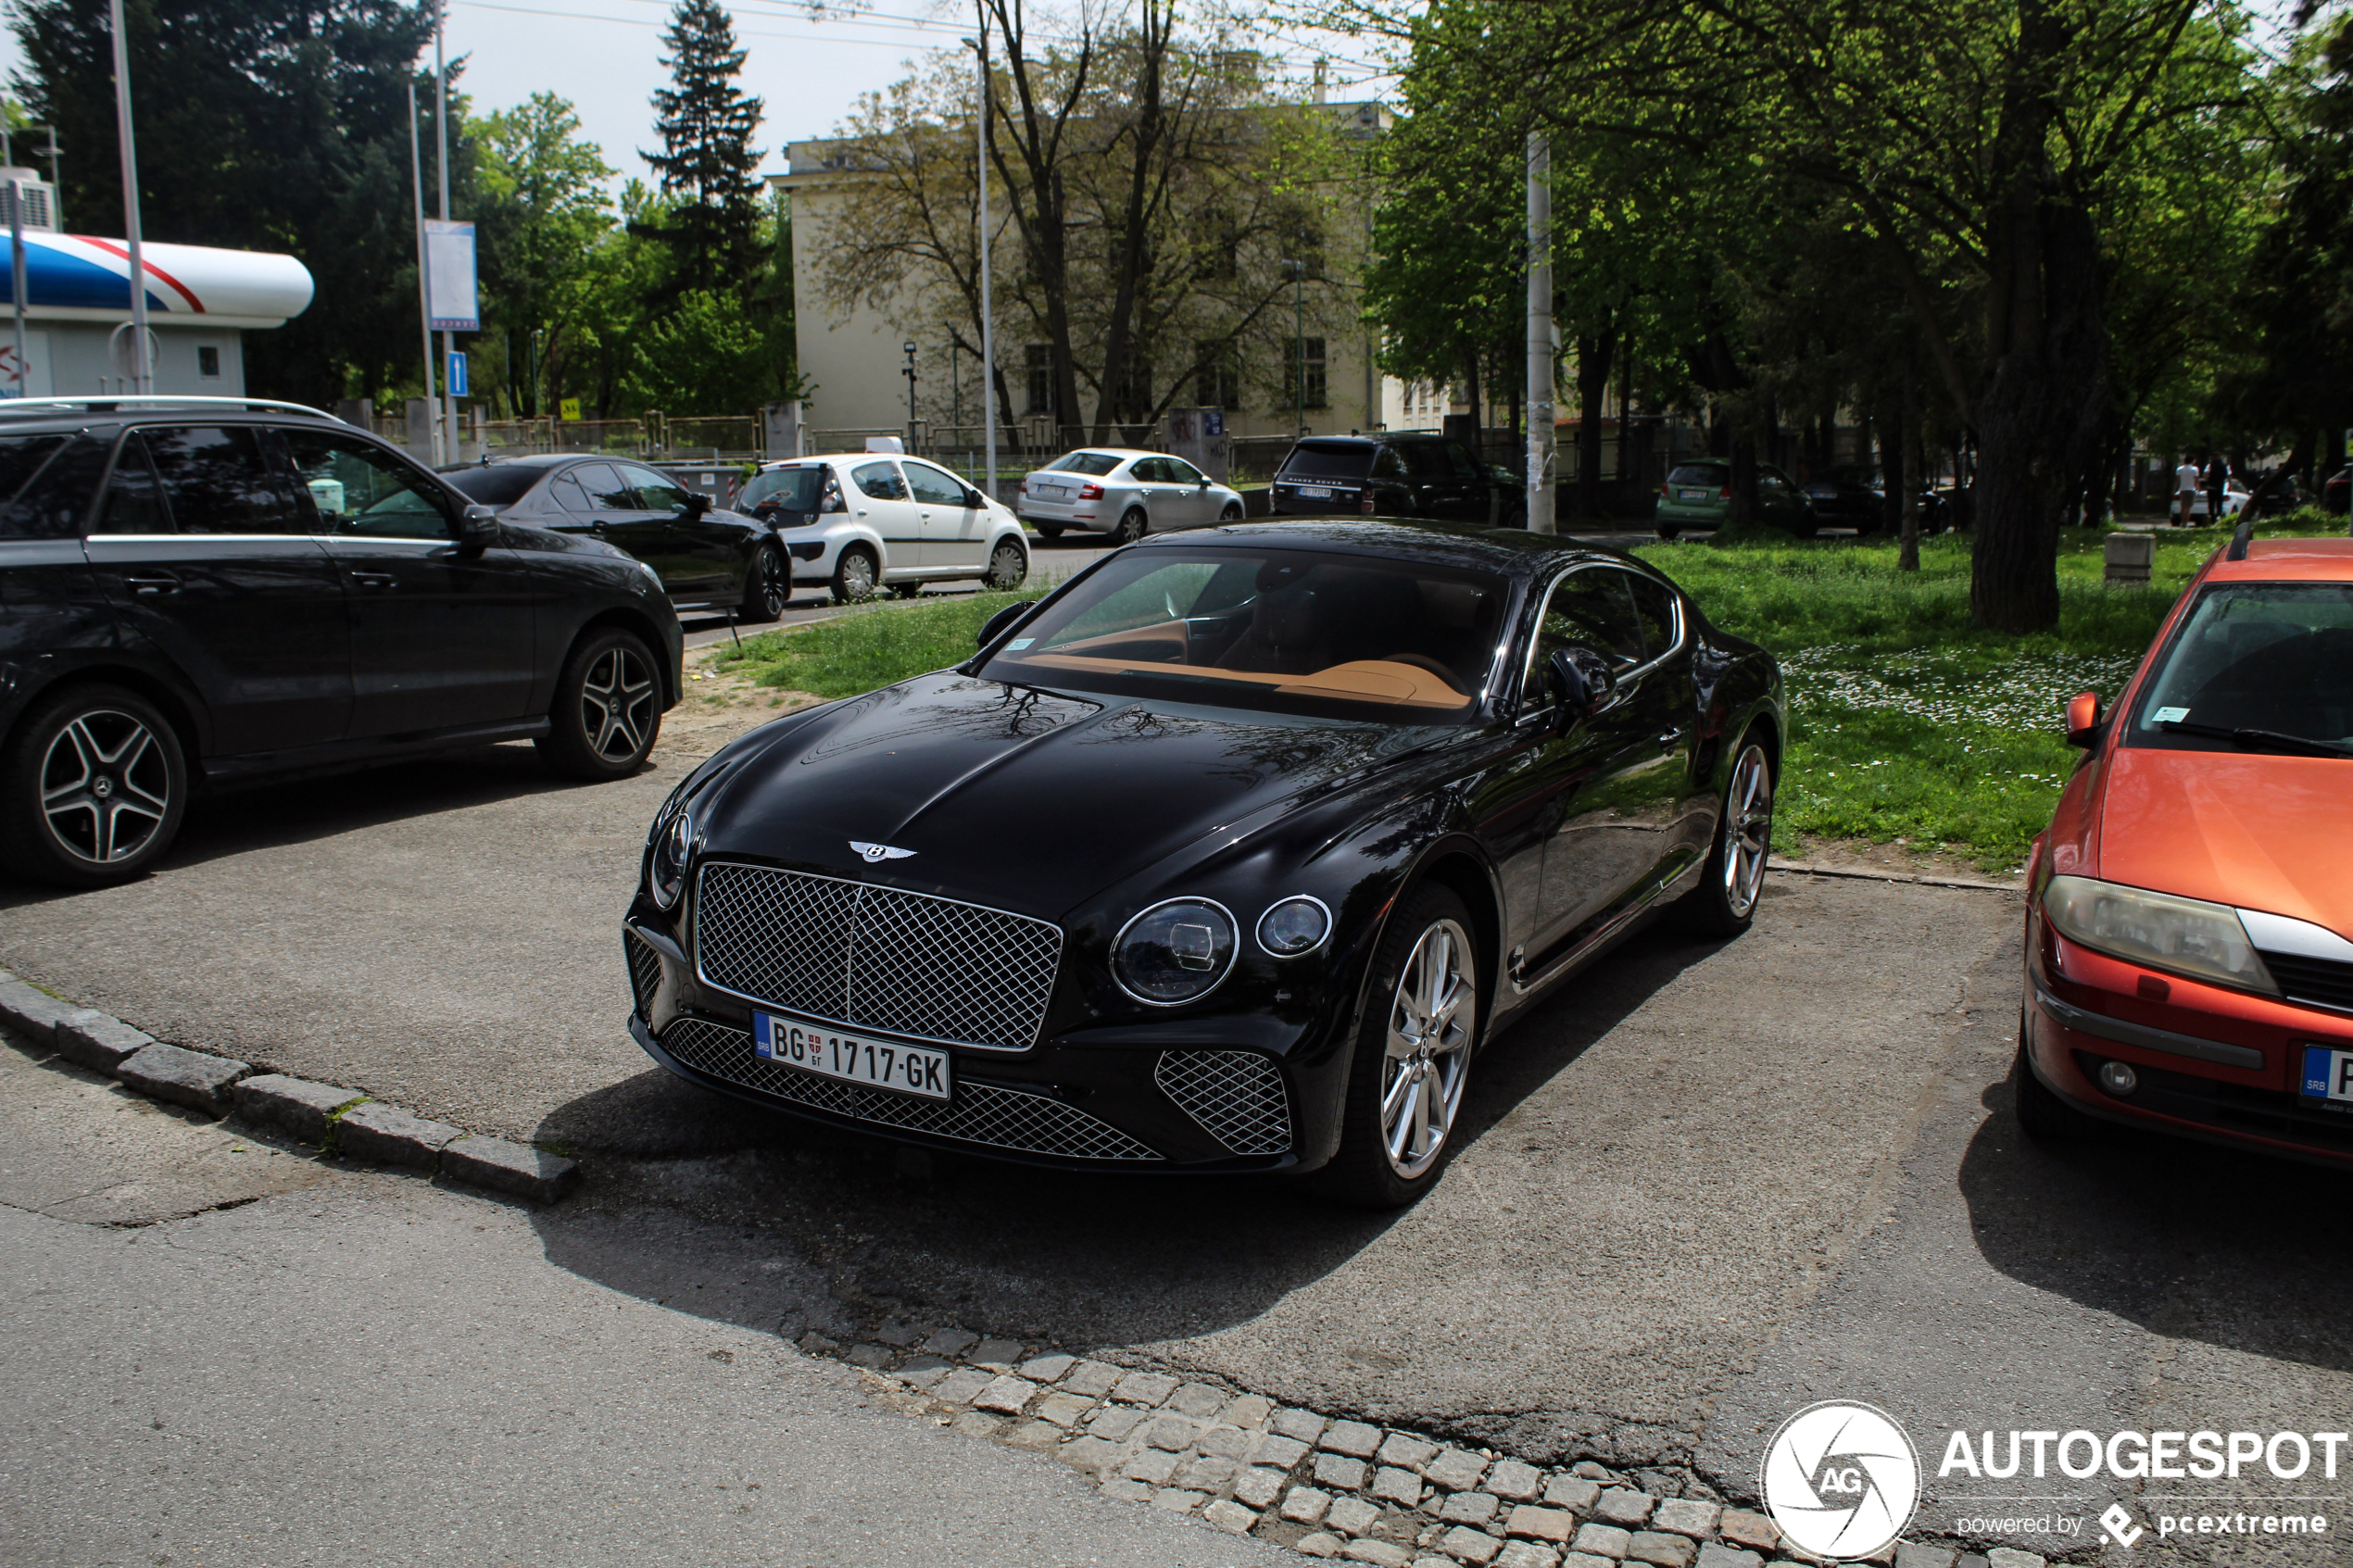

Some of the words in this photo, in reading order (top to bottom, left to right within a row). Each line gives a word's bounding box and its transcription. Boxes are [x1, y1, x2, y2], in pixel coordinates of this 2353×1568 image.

[758, 1041, 770, 1052] SRB
[774, 1022, 804, 1061] BG
[2307, 1079, 2325, 1091] SRB
